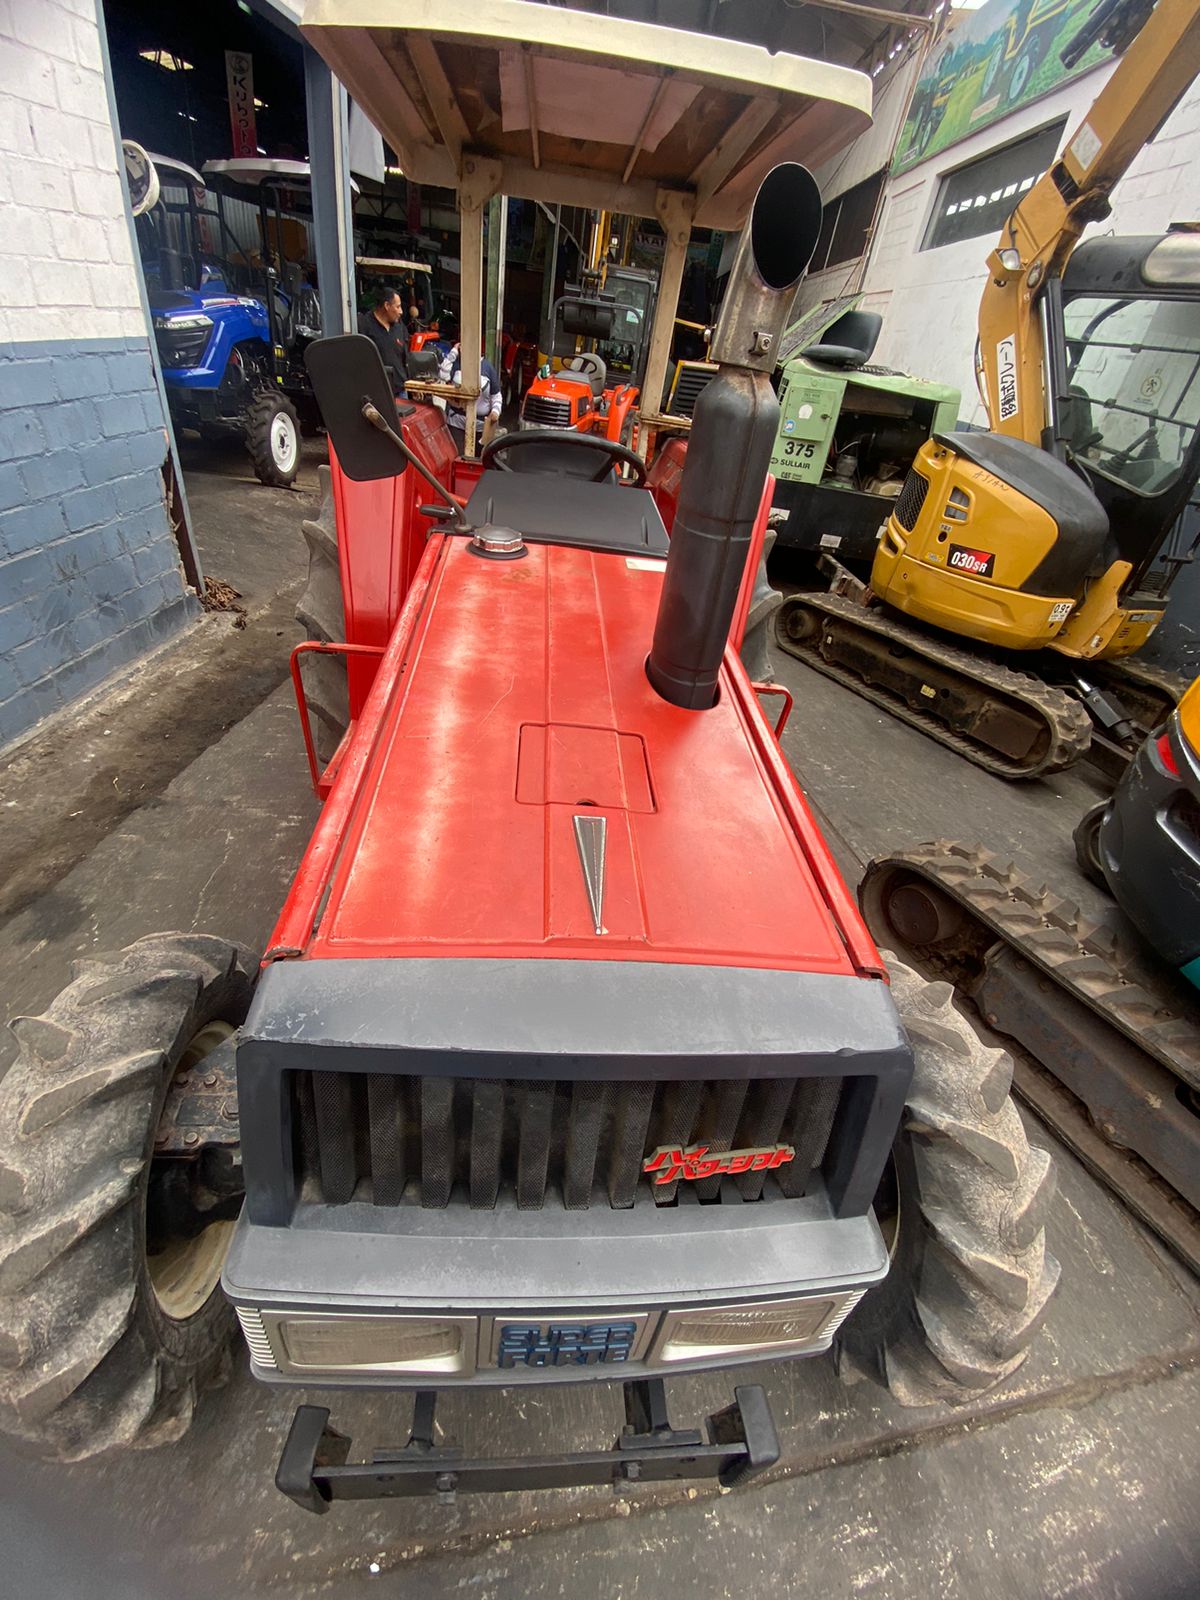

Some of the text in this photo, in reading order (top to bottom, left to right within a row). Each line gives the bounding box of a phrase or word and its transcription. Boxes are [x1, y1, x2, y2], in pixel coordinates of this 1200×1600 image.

[784, 441, 815, 458] 375
[780, 458, 811, 470] SULLAIR
[951, 551, 988, 573] 030SR
[501, 1322, 637, 1346] SUPER
[499, 1344, 630, 1369] FORTE
